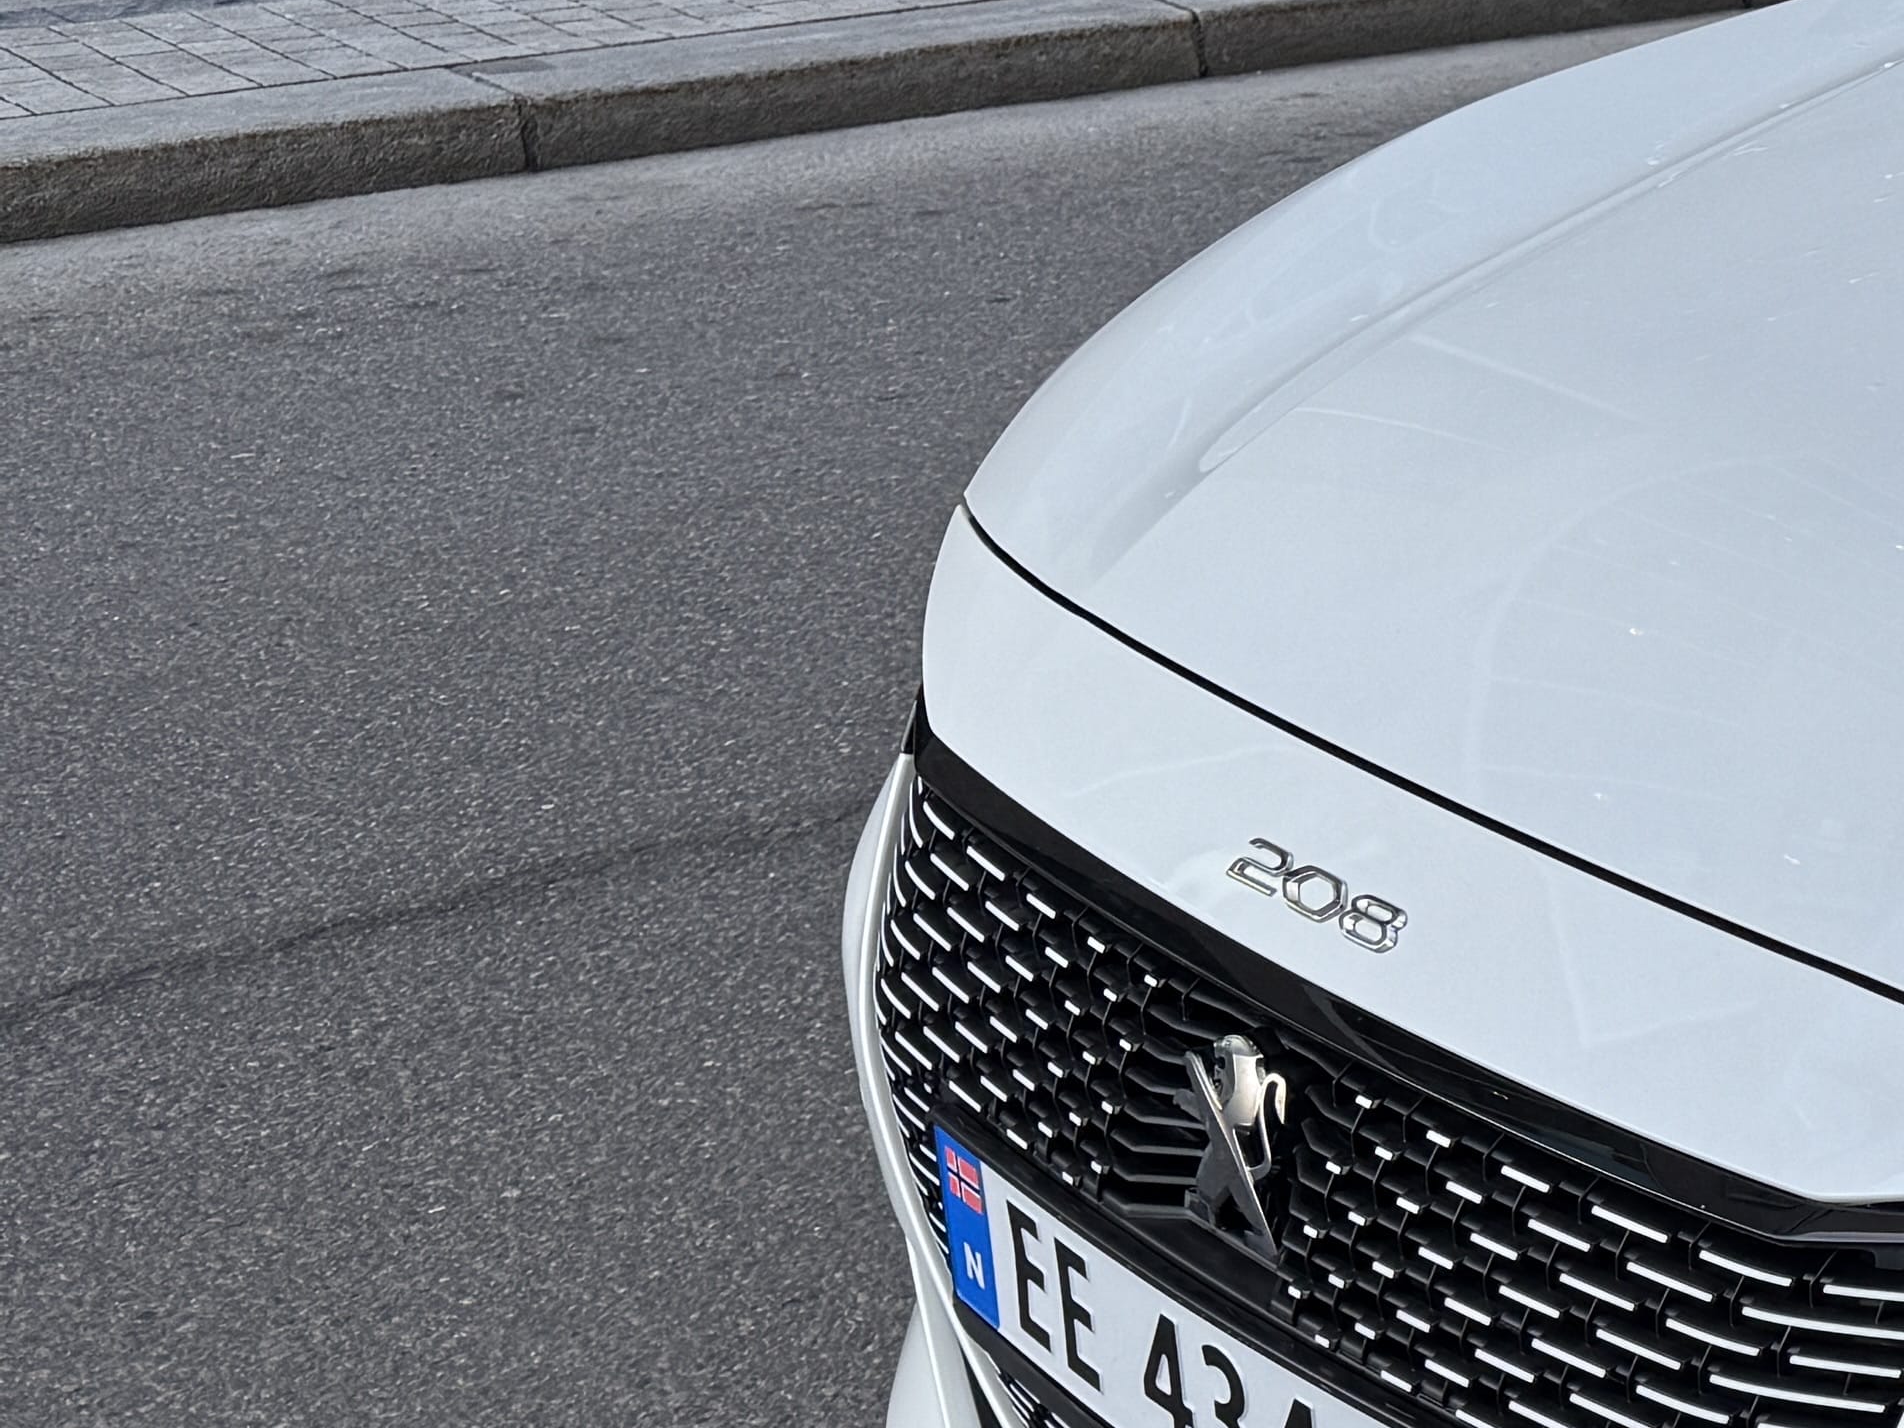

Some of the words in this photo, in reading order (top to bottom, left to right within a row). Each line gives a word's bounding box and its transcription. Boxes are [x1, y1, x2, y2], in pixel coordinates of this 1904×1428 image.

[1226, 837, 1409, 953] 208
[963, 1241, 986, 1290] N
[1006, 1199, 1102, 1393] EE
